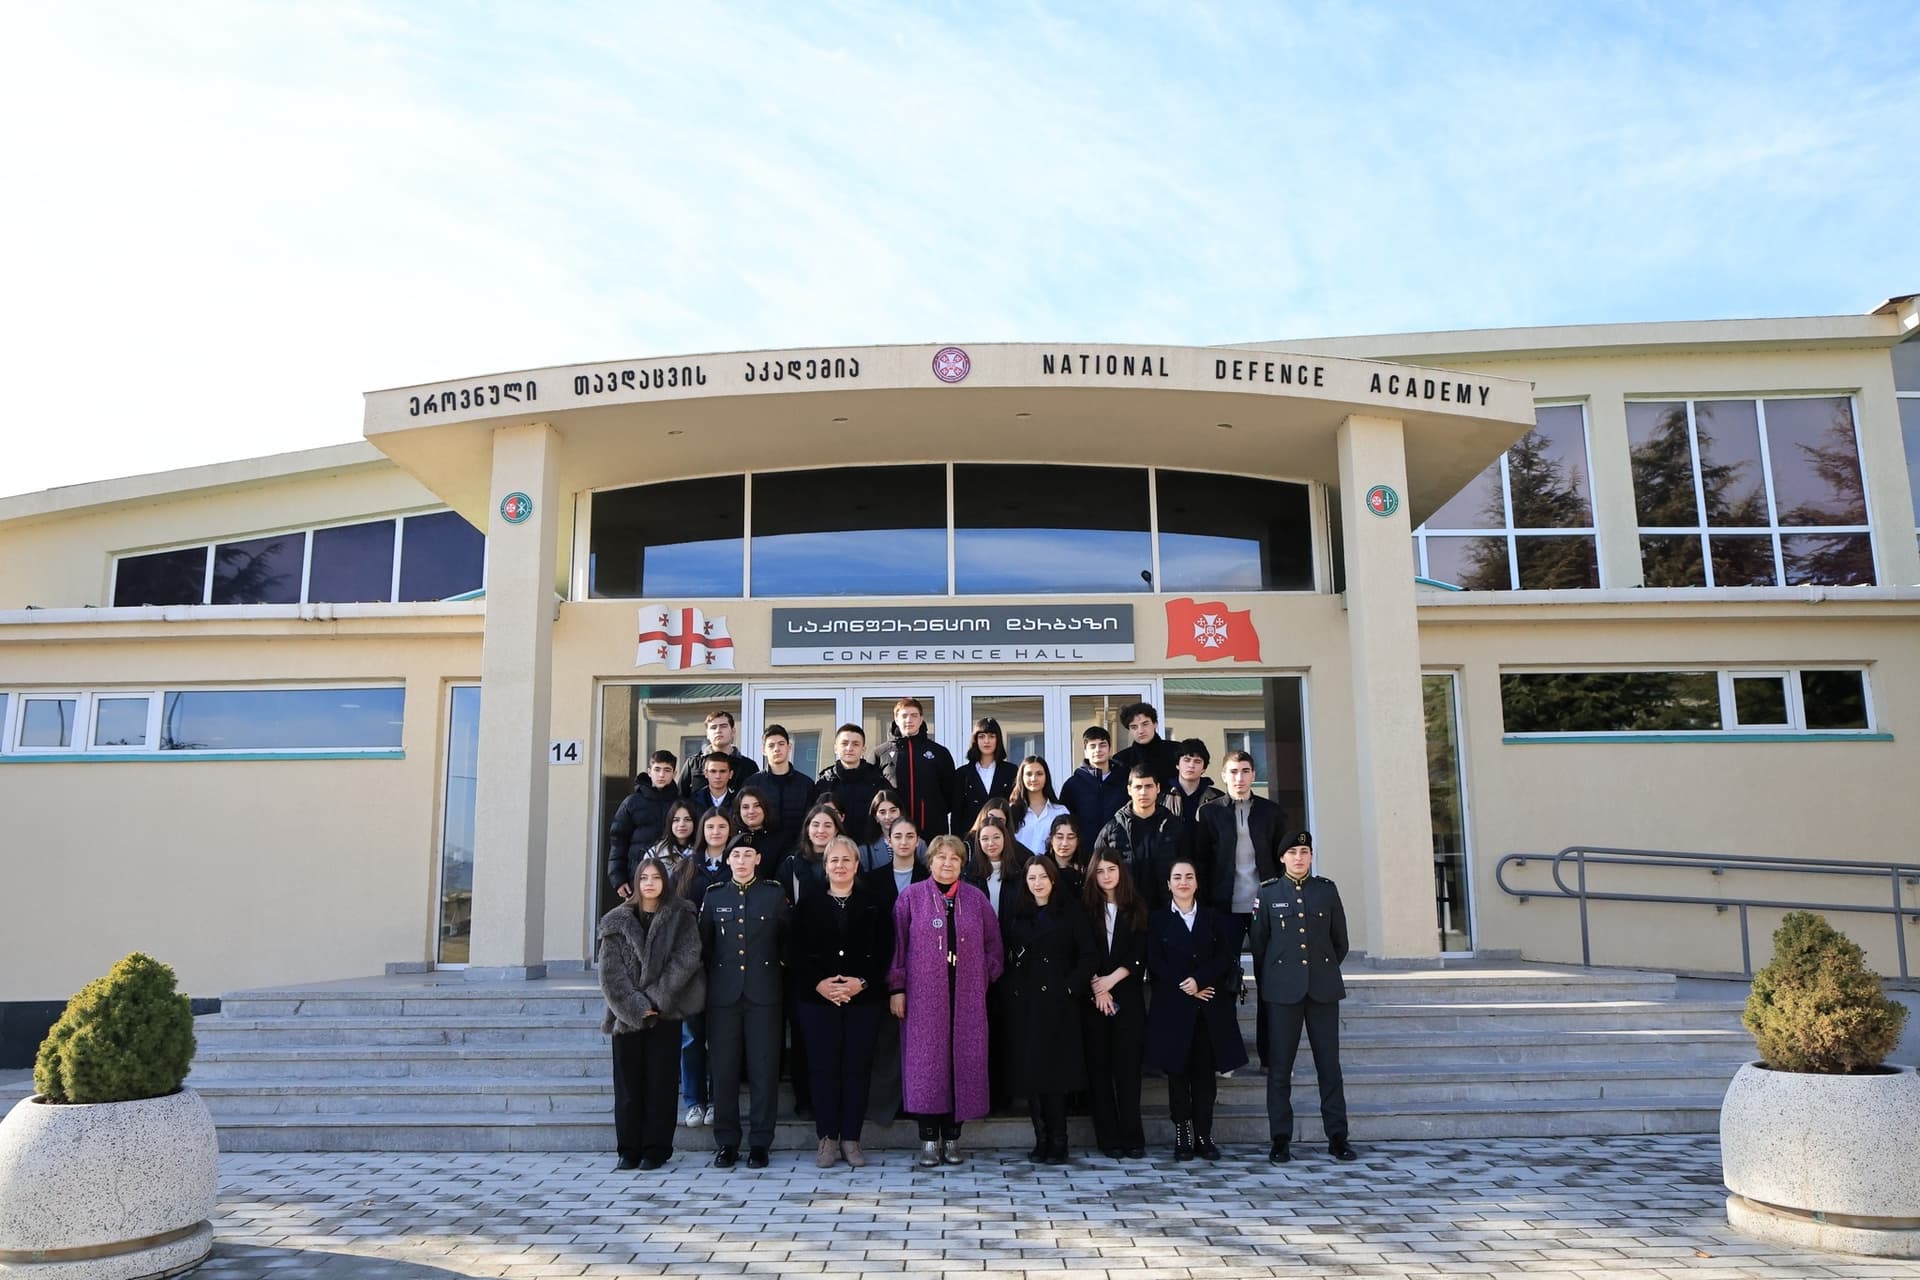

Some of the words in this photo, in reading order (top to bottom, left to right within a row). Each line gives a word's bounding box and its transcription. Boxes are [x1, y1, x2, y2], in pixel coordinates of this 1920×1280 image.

[409, 381, 538, 416] ეროვნული
[574, 366, 707, 395] თავდაცვის
[744, 357, 860, 382] აკადემია
[1042, 354, 1169, 377] NATIONAL
[1215, 359, 1325, 387] DEFENCE
[1370, 372, 1490, 406] ACADEMY
[788, 618, 990, 633] საკონფერენციო
[1006, 617, 1118, 631] დარბაზი
[822, 649, 1001, 661] CONFERENCE
[1015, 648, 1084, 659] HALL
[552, 742, 578, 761] 14
